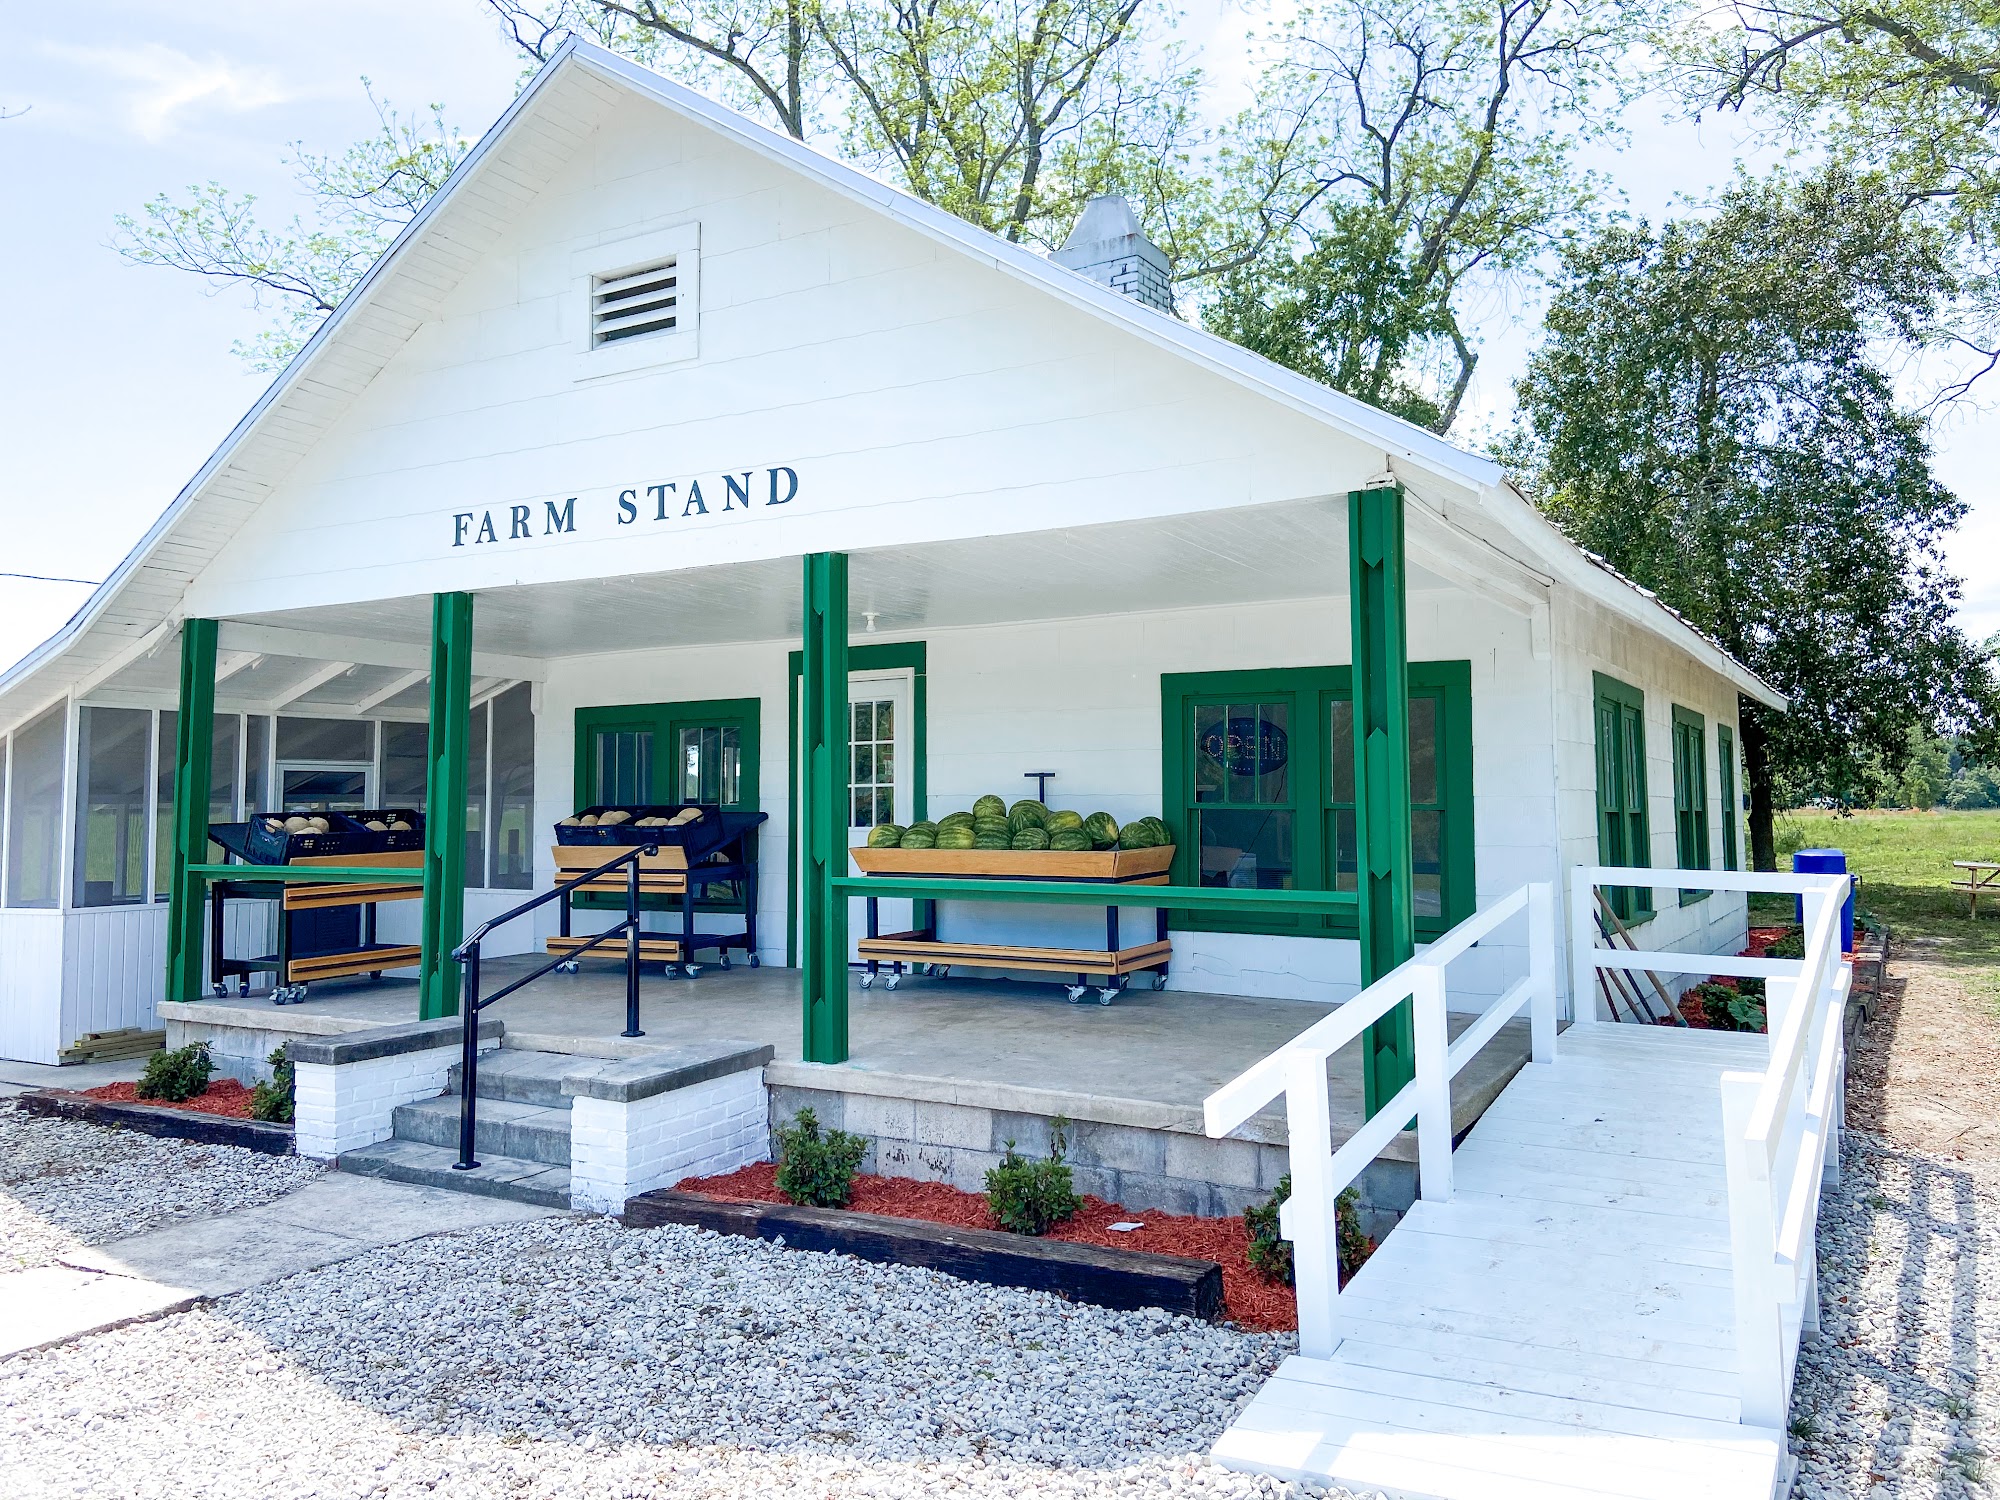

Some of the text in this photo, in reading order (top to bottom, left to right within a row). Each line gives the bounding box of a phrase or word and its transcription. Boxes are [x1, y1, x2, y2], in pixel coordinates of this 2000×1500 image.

[452, 466, 798, 547] FARM STAND
[1206, 735, 1282, 760] OPEN
